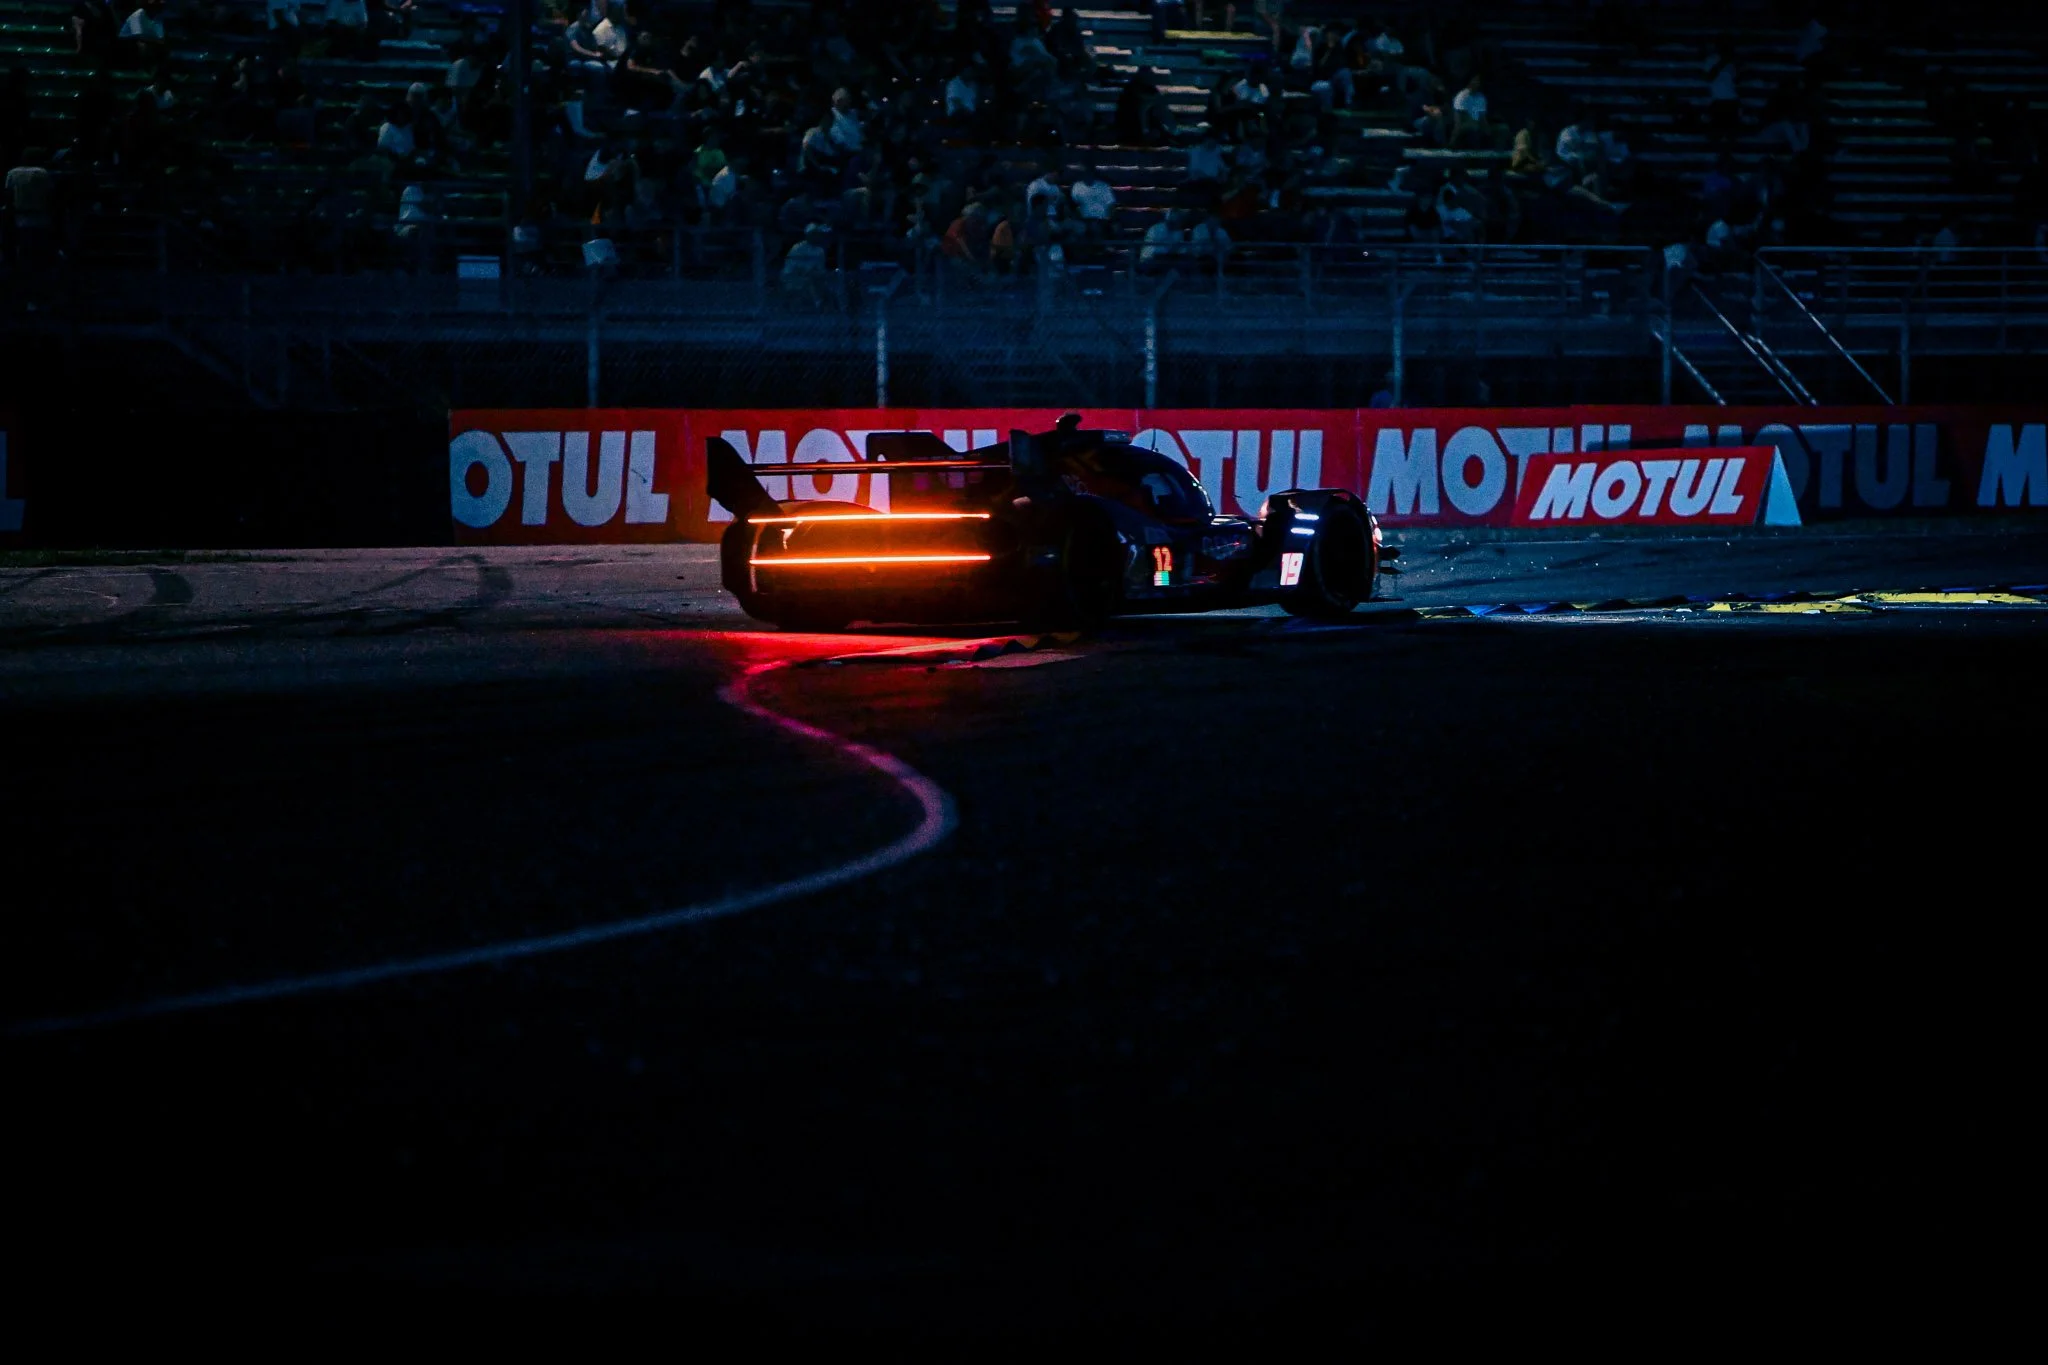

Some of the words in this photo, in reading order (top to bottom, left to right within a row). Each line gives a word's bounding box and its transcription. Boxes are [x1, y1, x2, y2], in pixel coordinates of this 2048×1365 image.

[1529, 457, 1746, 519] MOTUL
[1684, 421, 1951, 509] OTUL
[1153, 546, 1172, 571] 12
